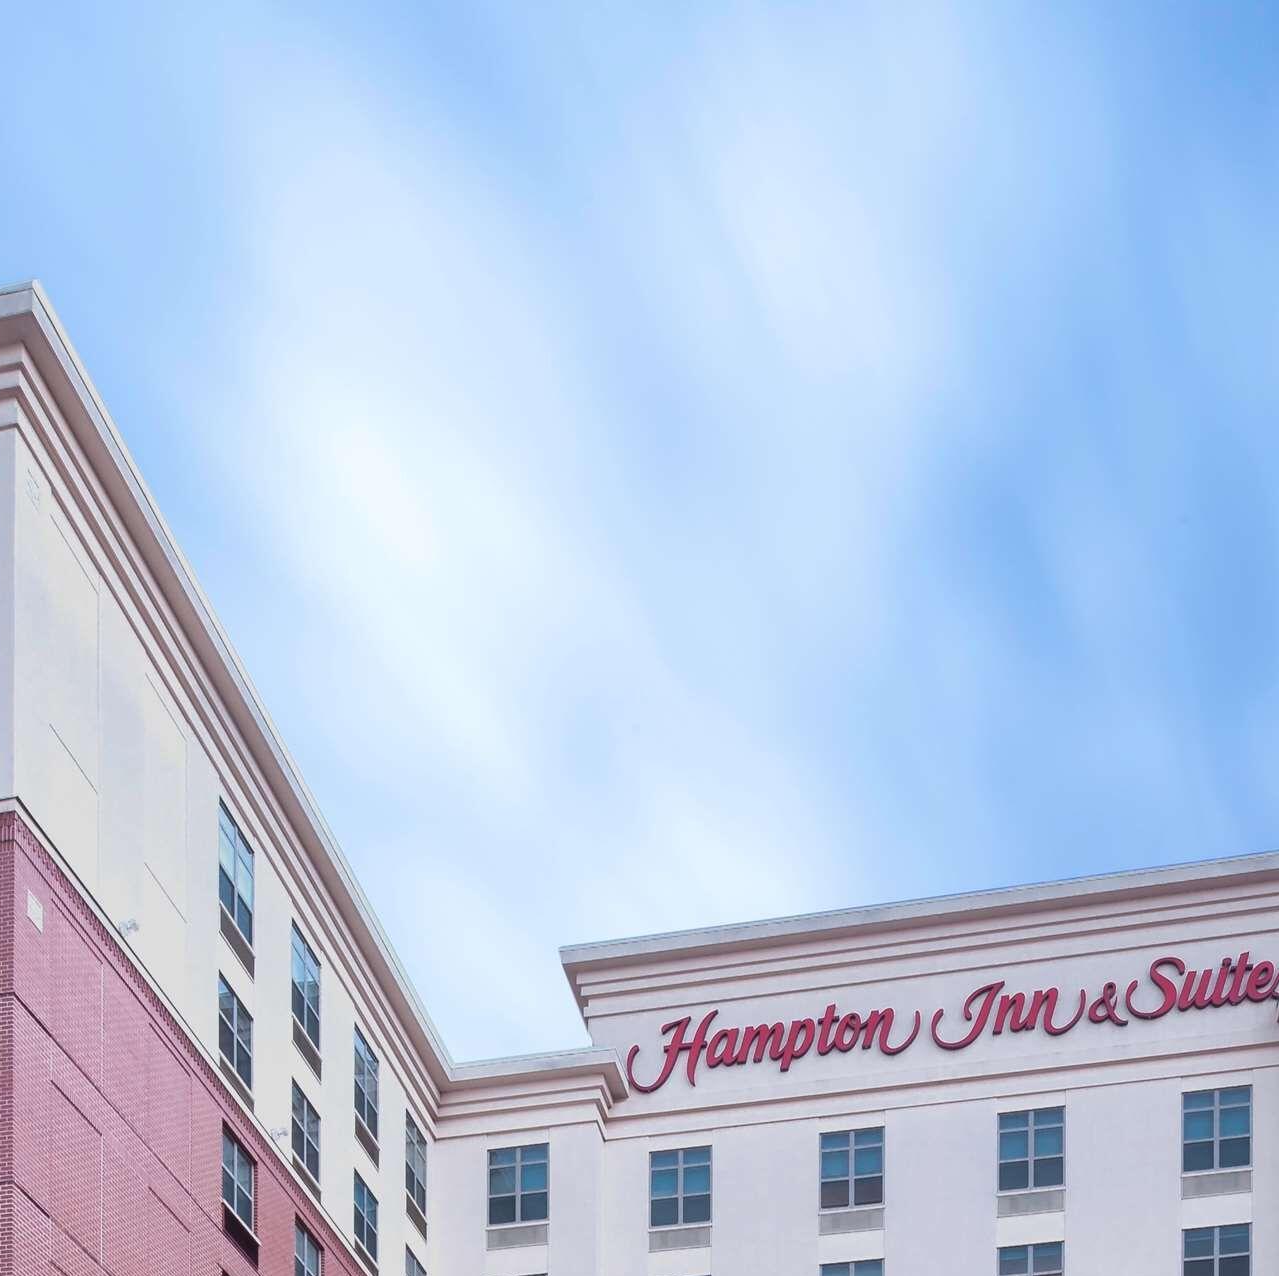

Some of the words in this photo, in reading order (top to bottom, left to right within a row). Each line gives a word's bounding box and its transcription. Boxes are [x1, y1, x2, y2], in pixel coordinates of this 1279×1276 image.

[627, 1001, 920, 1093] Hampton
[931, 981, 1086, 1051] Inn
[1088, 982, 1128, 1026] &
